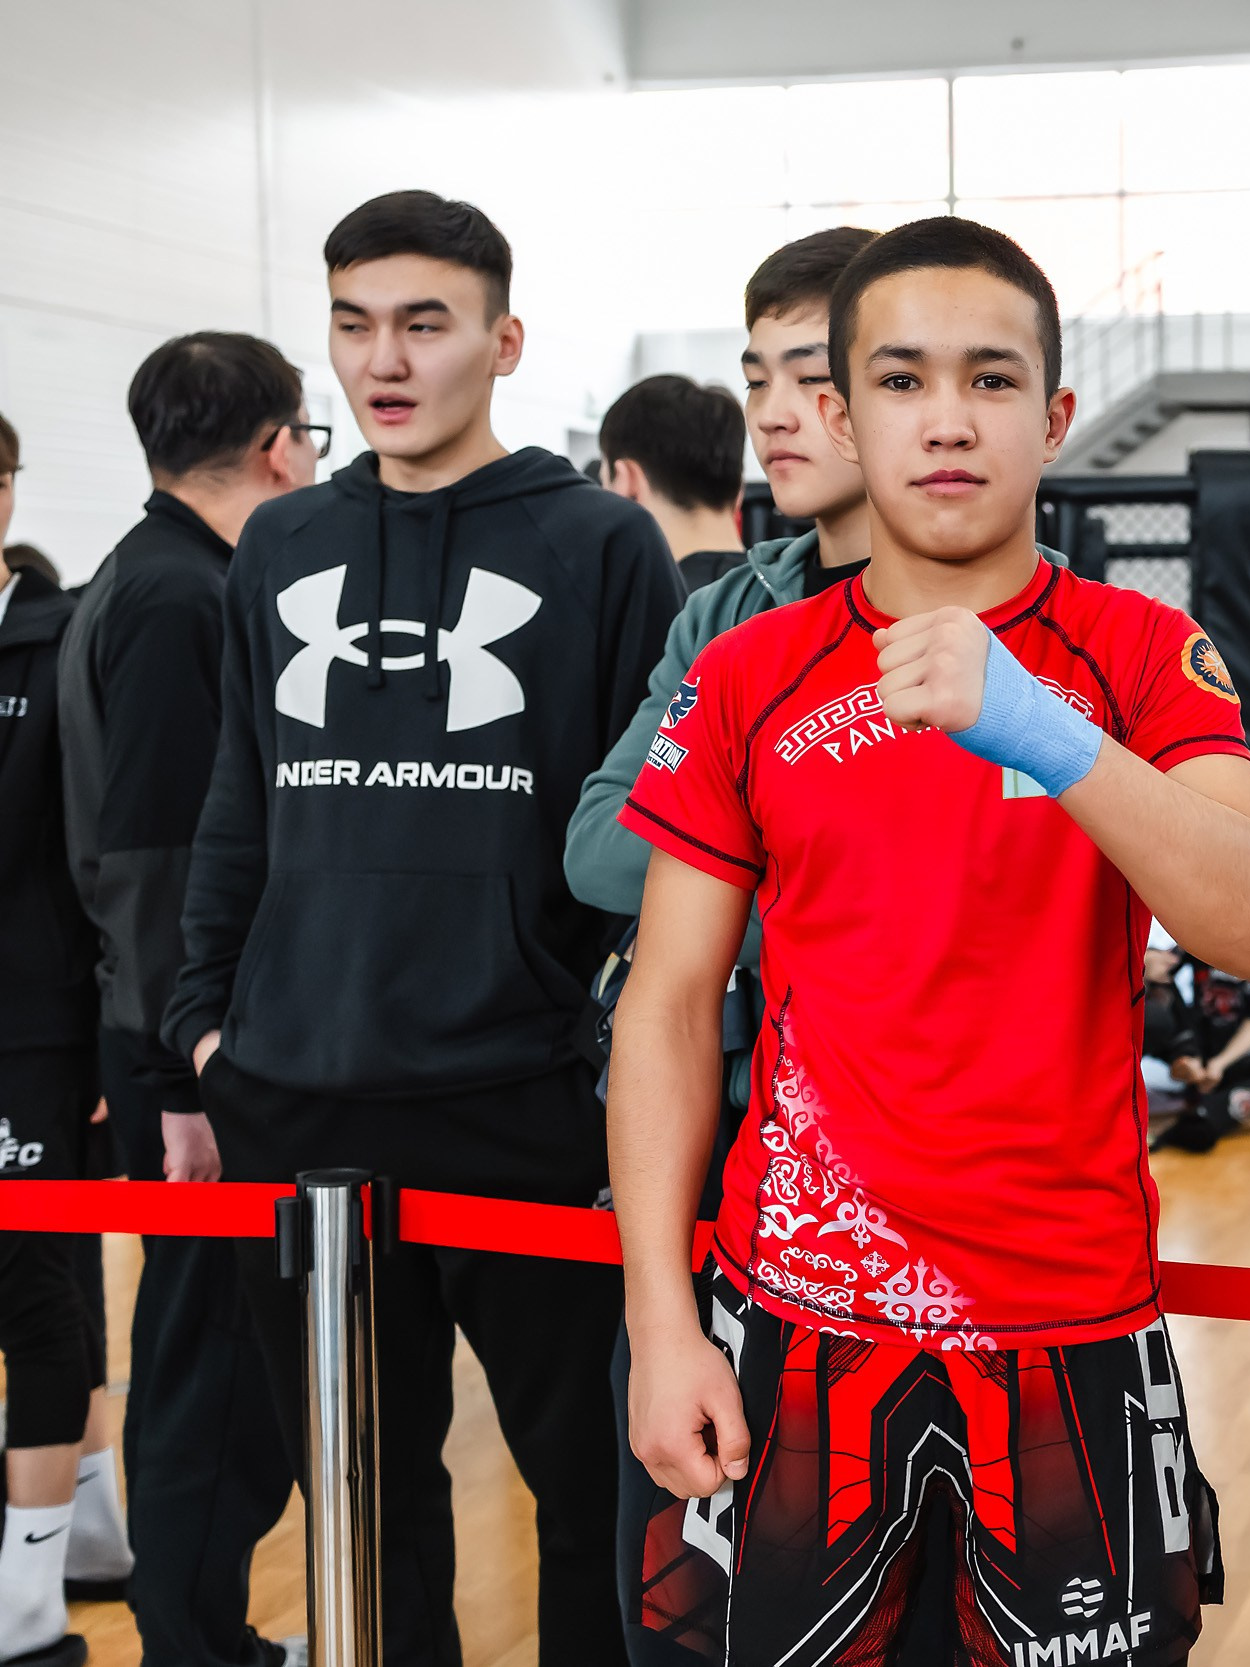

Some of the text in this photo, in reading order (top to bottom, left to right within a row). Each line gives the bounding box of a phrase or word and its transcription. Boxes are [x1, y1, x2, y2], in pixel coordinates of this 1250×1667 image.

[276, 759, 534, 795] NDER ARMOUR
[1014, 1611, 1151, 1667] IMMAF
